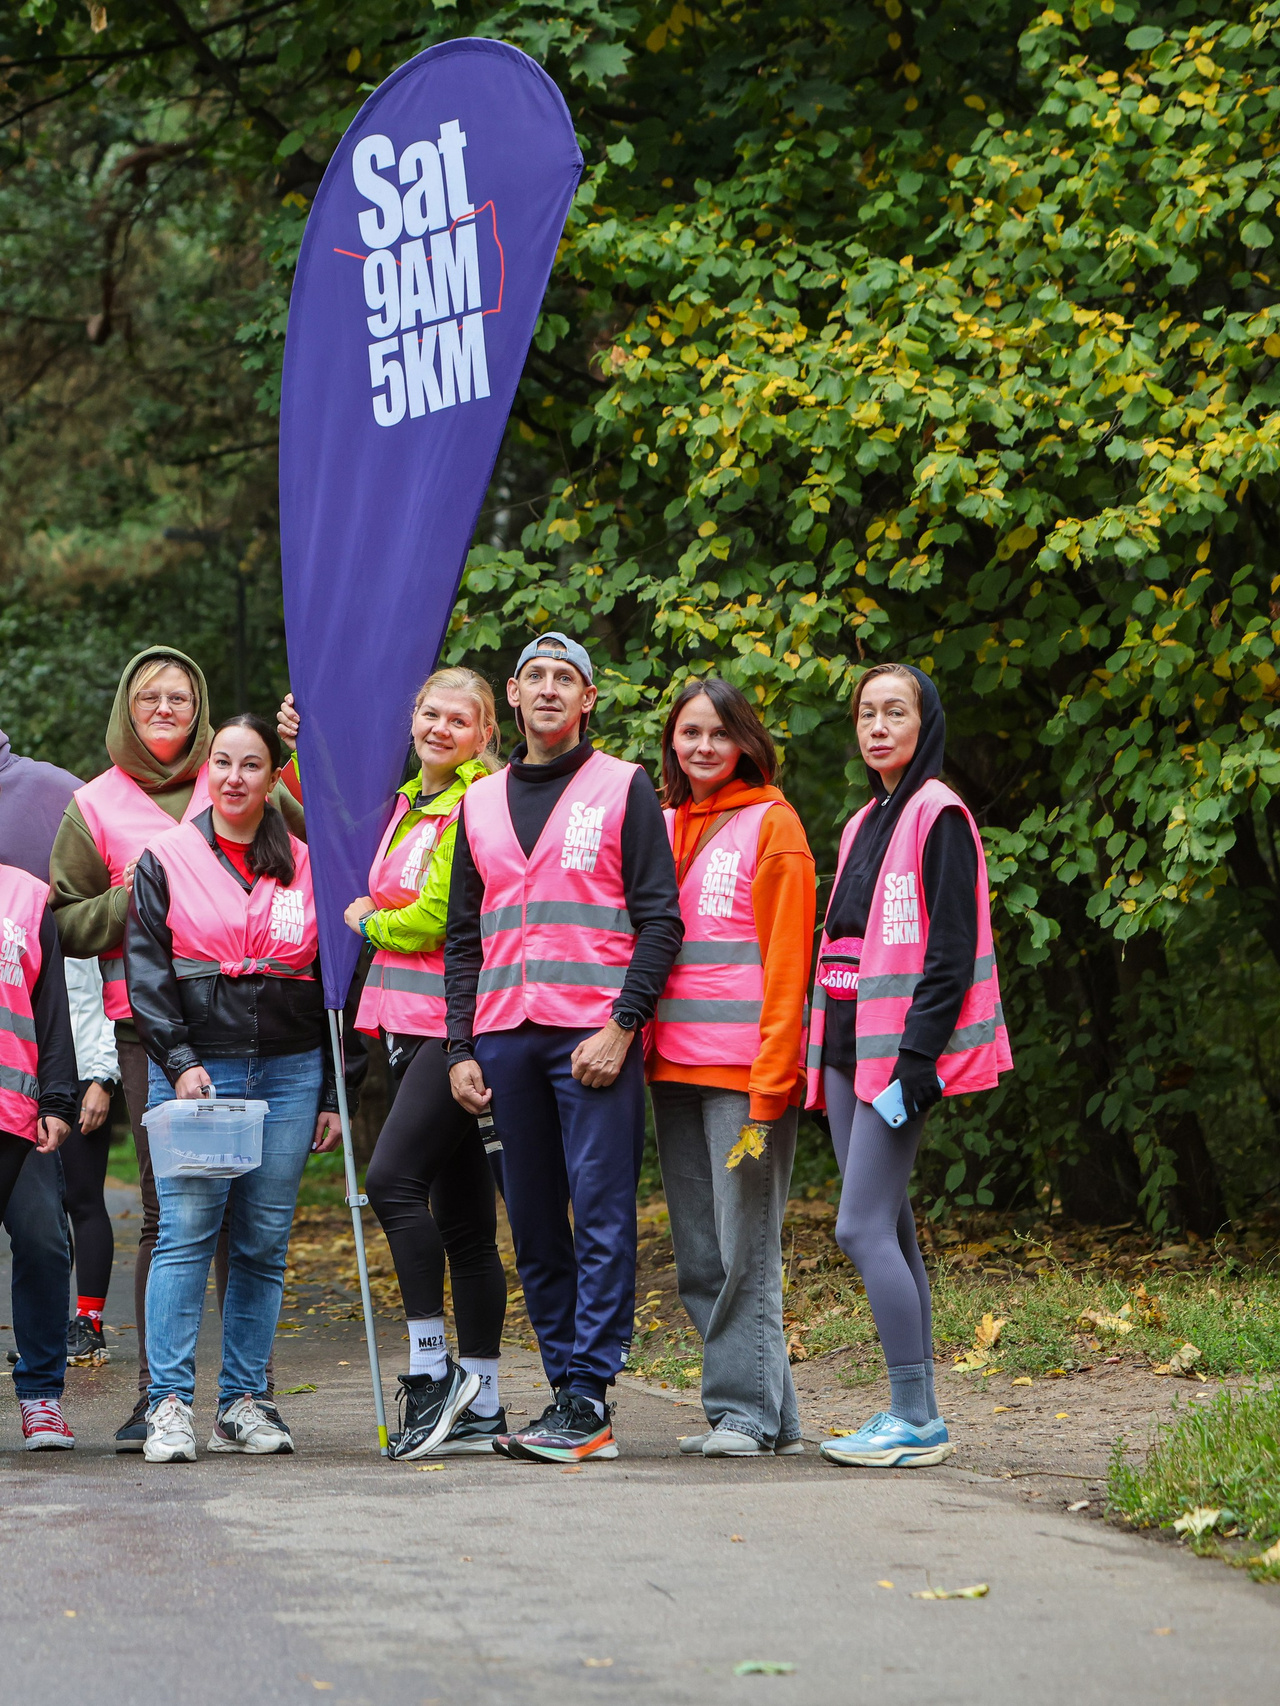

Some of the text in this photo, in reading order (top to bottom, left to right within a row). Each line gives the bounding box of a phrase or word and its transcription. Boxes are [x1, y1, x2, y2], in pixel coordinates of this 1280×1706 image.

[352, 119, 475, 249] Sat
[363, 222, 481, 338] 9AM
[368, 311, 491, 427] 5KM
[568, 801, 606, 829] Sat
[564, 826, 602, 851] 9AM
[561, 847, 598, 873] 5KM
[706, 847, 741, 875] Sat
[701, 872, 737, 897] 9AM
[884, 871, 917, 900] Sat
[272, 886, 304, 910] Sat
[697, 894, 733, 918] 5KM
[883, 899, 918, 922] 9AM
[271, 904, 304, 927] 9AM
[3, 917, 27, 950] Sat
[270, 920, 304, 946] 5KM
[882, 921, 919, 945] 5KM
[418, 1335, 443, 1348] M42.2
